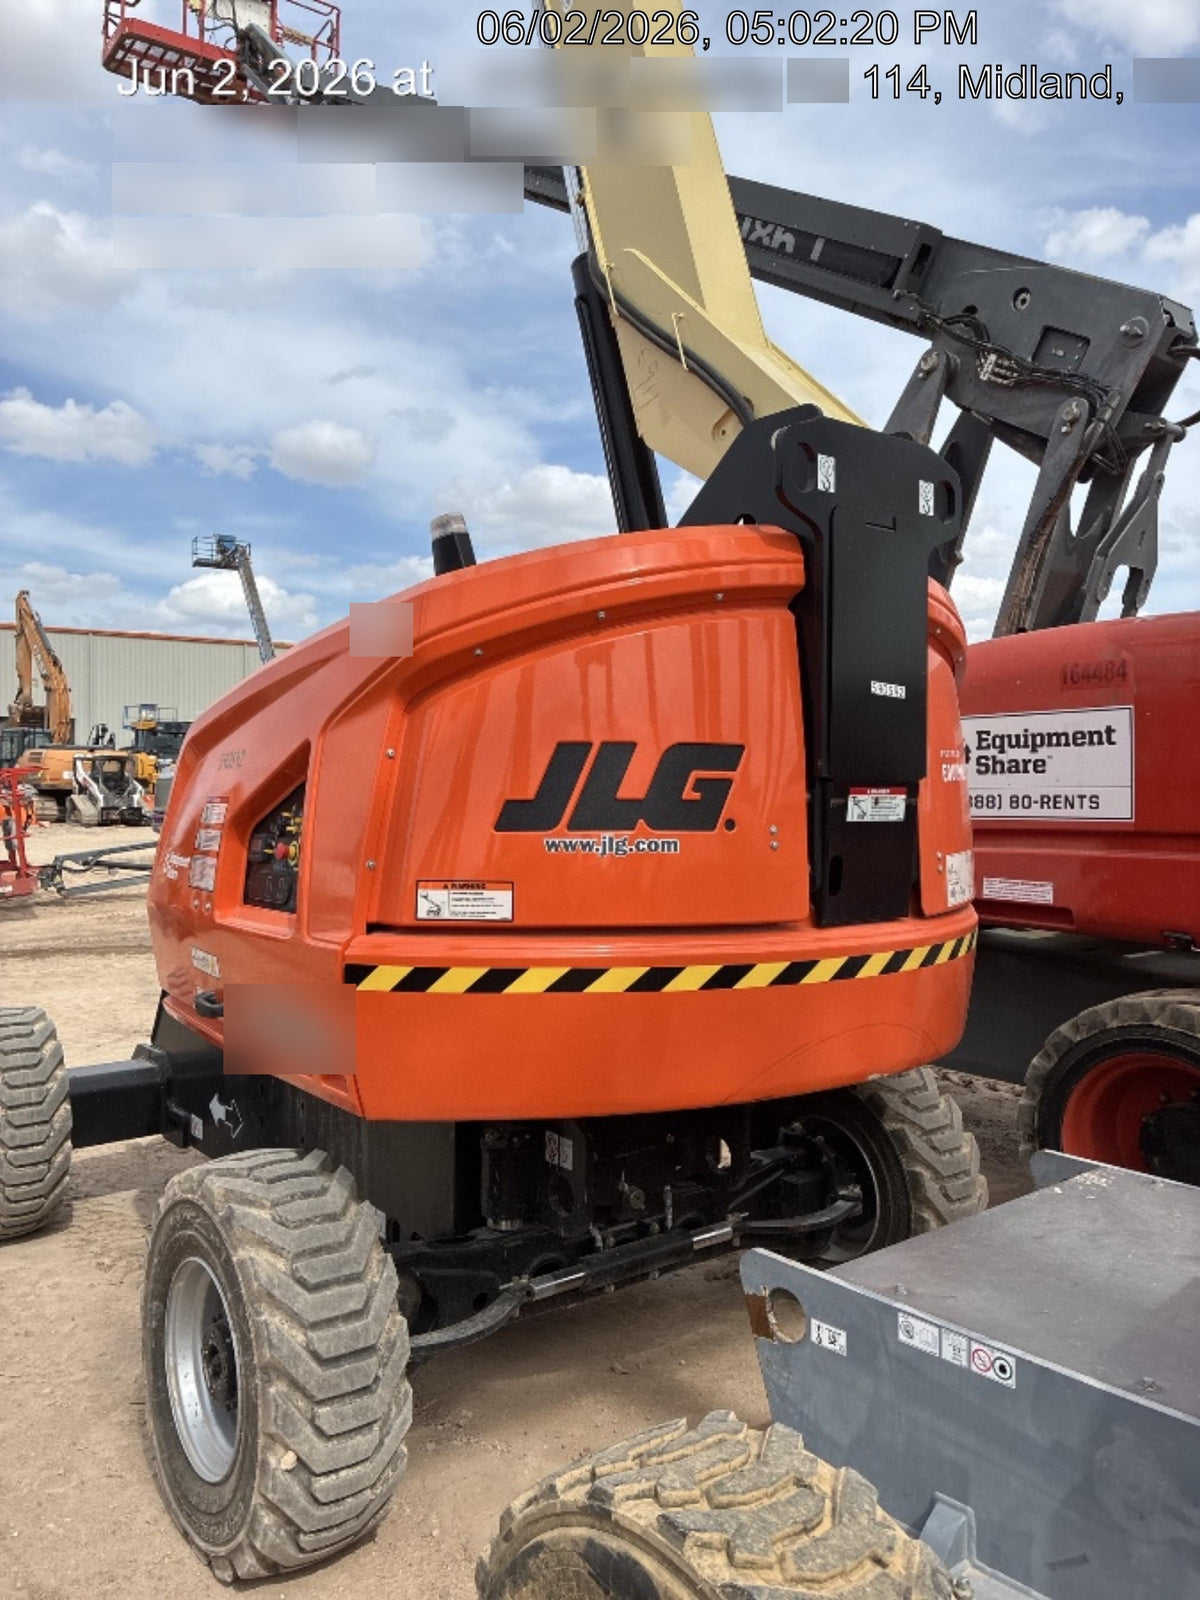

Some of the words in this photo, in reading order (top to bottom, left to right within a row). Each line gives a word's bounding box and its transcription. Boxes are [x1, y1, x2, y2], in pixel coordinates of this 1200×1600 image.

[976, 725, 1117, 754] Equipment
[976, 755, 1047, 776] Share
[1009, 794, 1100, 810] 80-RENTS
[544, 836, 679, 857] www.jlg.com
